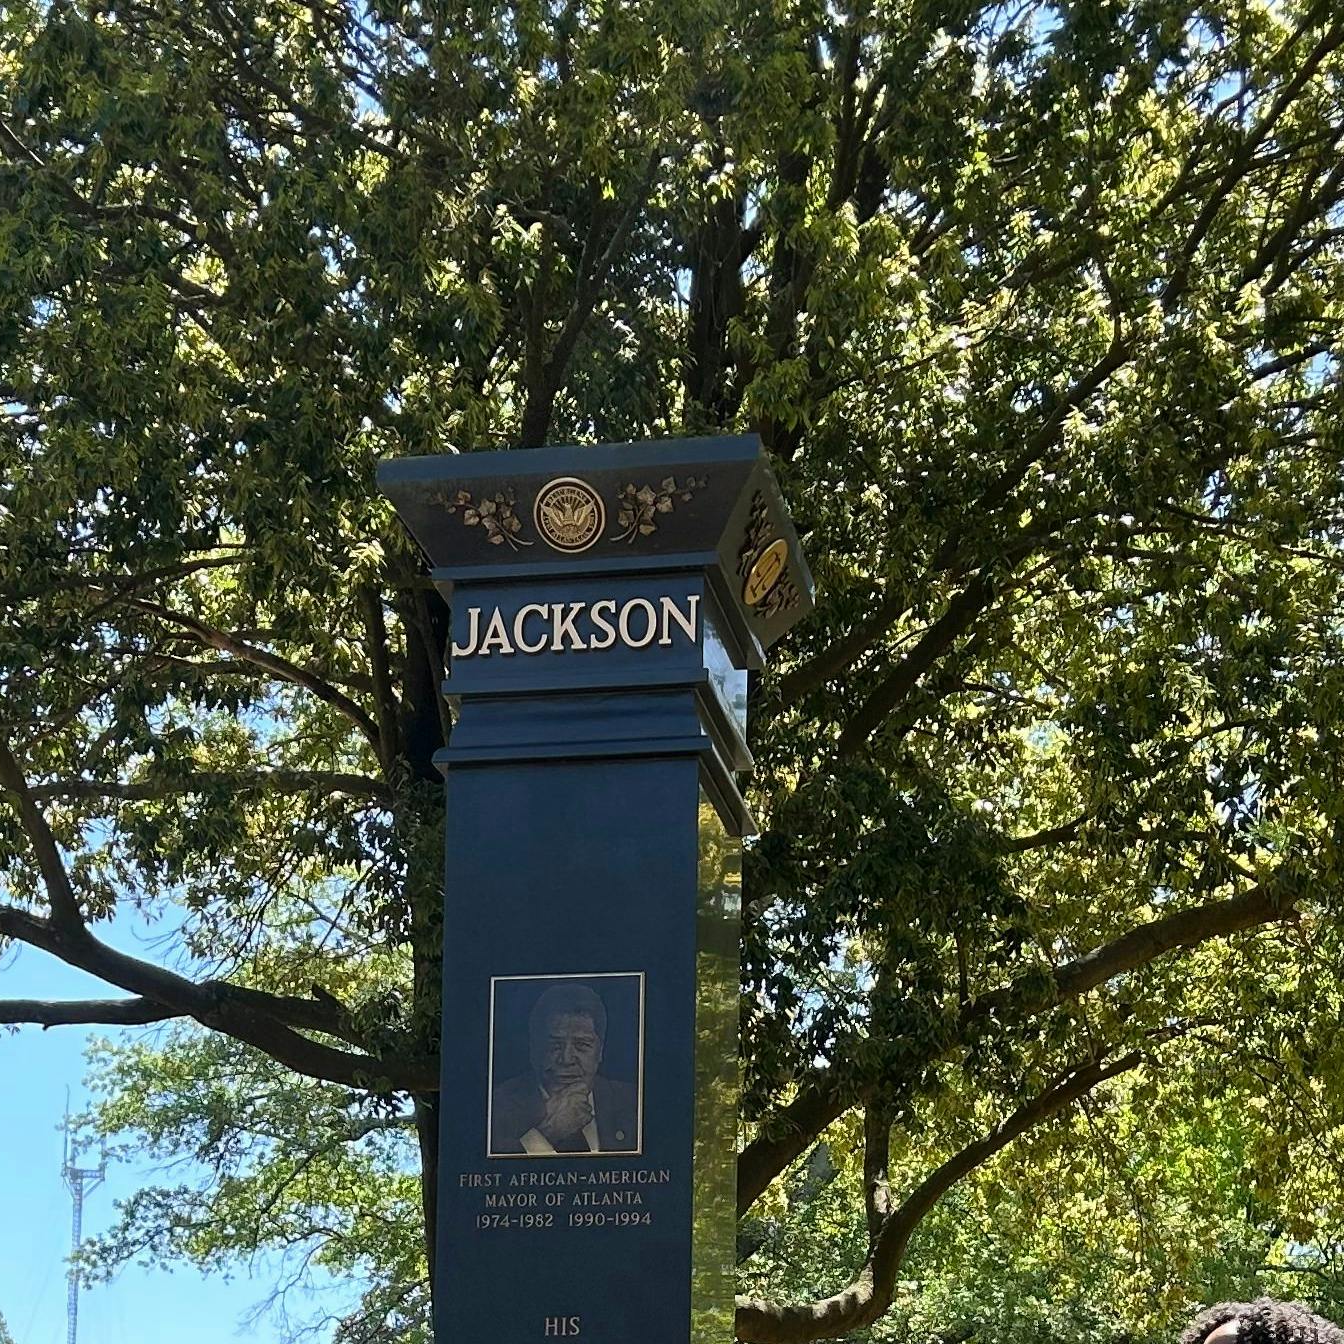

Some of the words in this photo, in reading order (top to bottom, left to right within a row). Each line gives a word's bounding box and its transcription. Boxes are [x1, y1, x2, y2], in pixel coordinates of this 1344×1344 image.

[451, 595, 701, 657] JACKSON
[459, 1173, 502, 1188] FIRST
[509, 1169, 670, 1187] AFRICAN-AMERICAN
[485, 1193, 538, 1208] MAYOR
[545, 1192, 565, 1207] OF
[572, 1190, 643, 1206] ATLANTA
[476, 1213, 554, 1229] 1974-1982
[569, 1211, 652, 1227] 1990-1994
[544, 1316, 580, 1336] HIS
